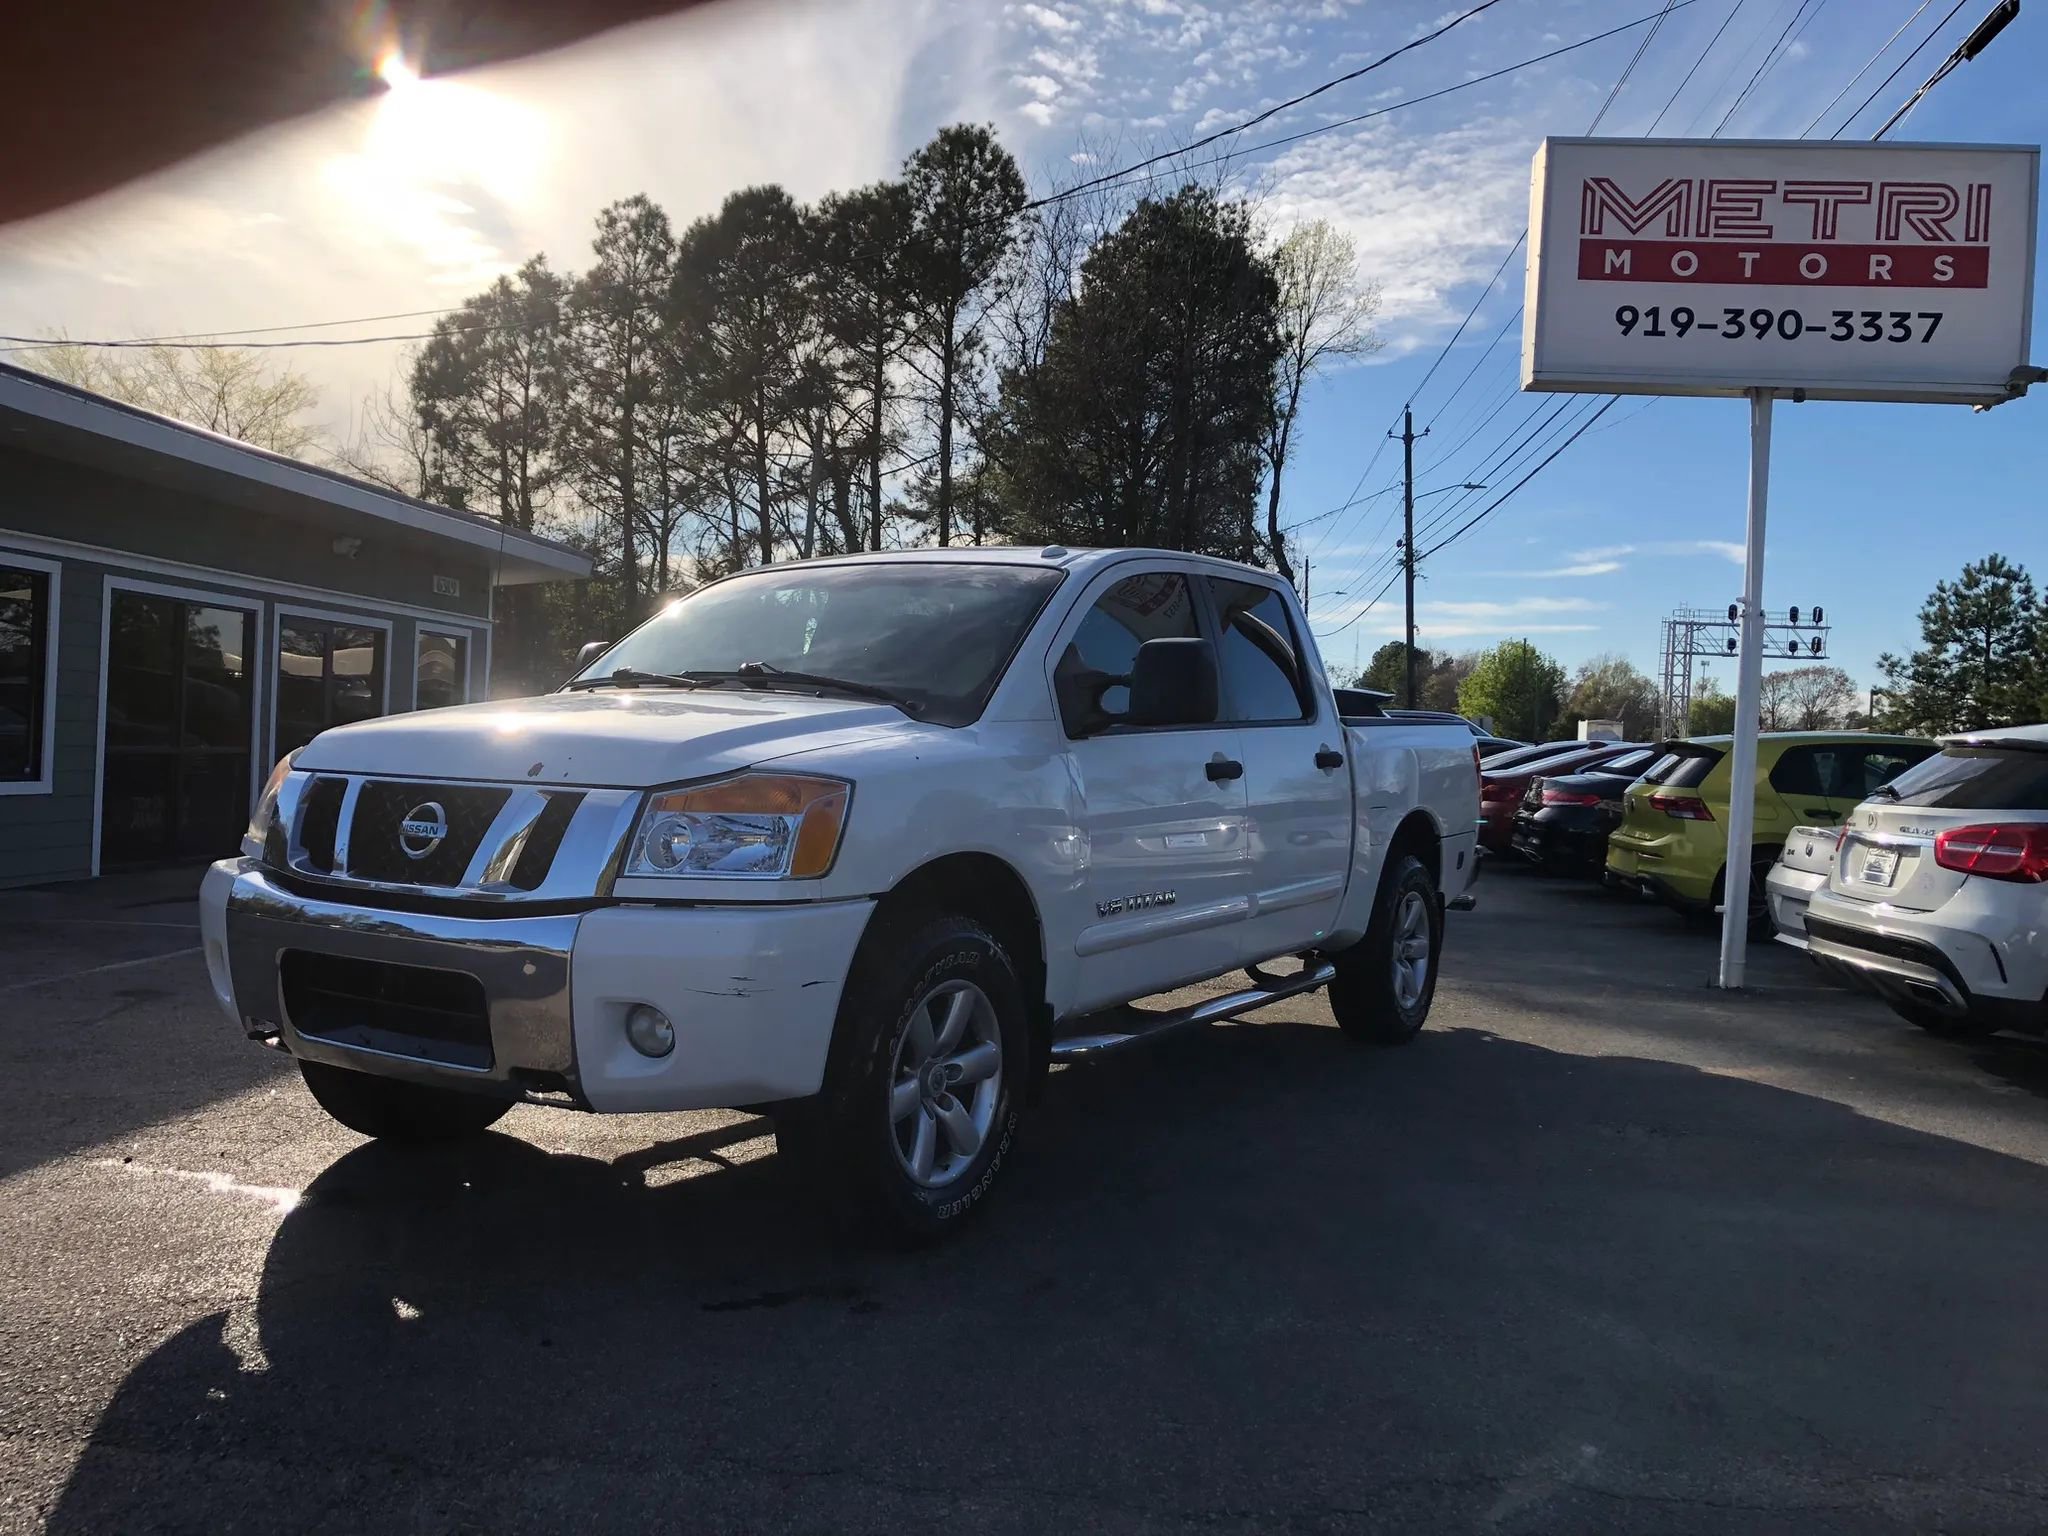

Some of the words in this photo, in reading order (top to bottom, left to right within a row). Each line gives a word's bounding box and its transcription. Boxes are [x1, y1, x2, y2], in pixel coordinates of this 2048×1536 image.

[1580, 177, 1992, 242] METRI
[1604, 248, 1955, 281] MOTORS
[1615, 305, 1943, 343] 919-390-3337
[402, 824, 439, 835] NISSAN
[1124, 890, 1176, 912] TITAN
